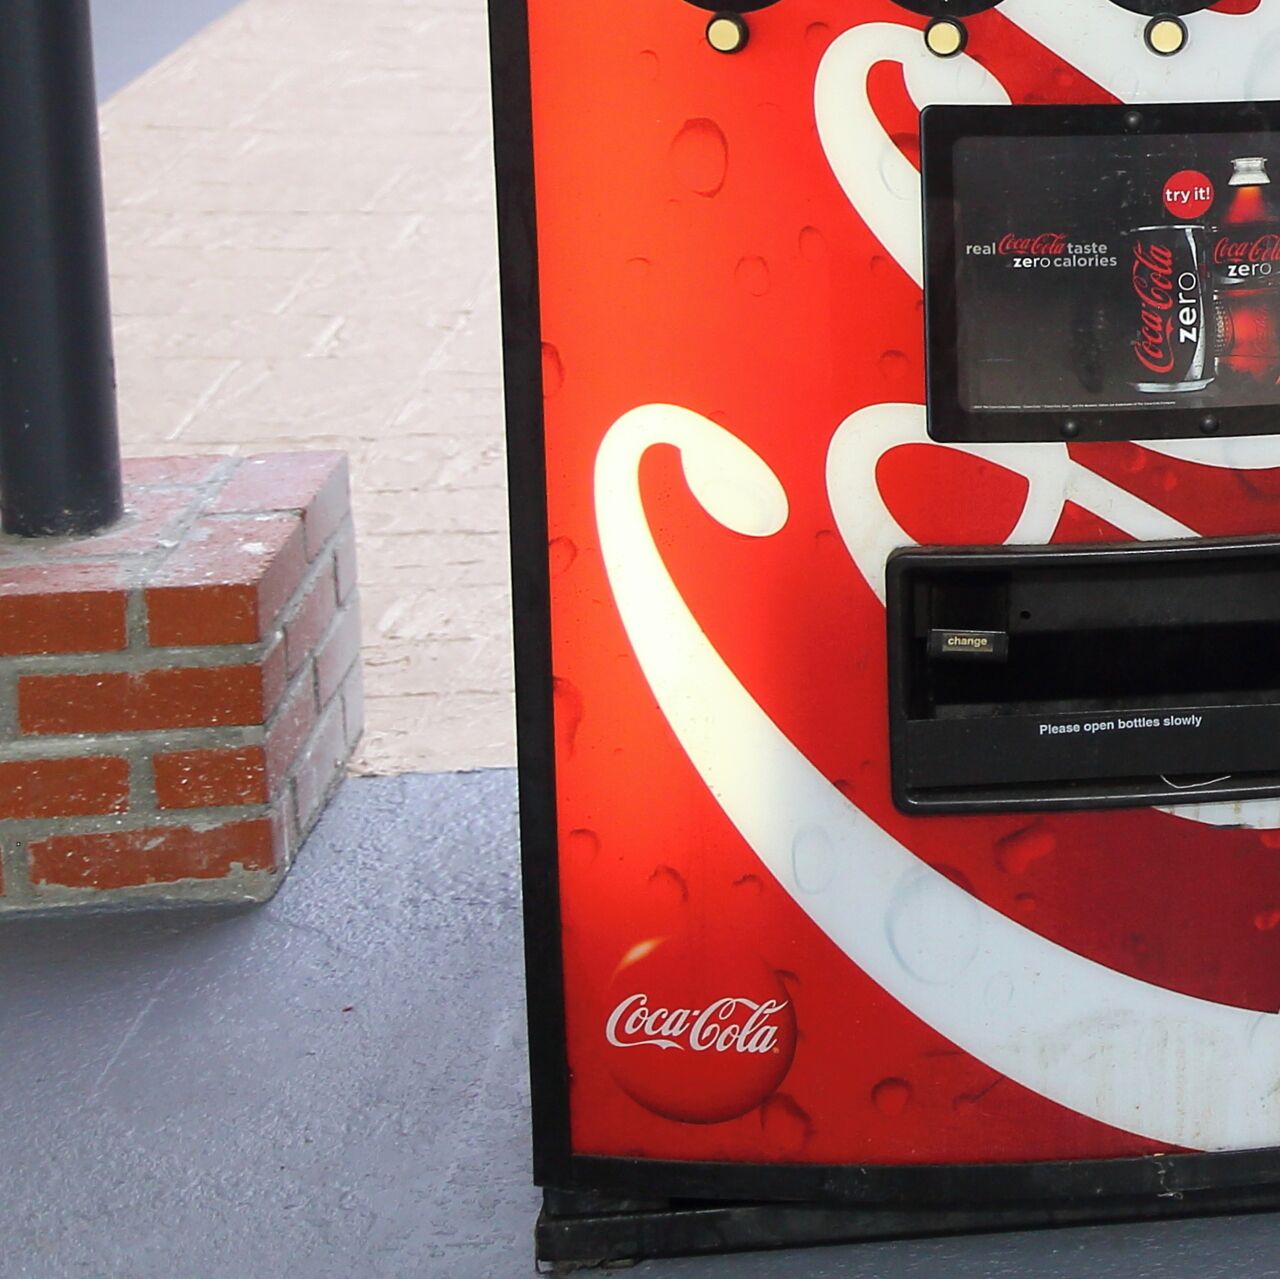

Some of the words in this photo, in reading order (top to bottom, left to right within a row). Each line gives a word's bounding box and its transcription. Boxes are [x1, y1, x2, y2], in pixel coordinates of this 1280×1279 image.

[1165, 188, 1190, 203] try
[1194, 187, 1211, 201] it!
[966, 243, 996, 256] real
[998, 232, 1070, 256] Coca-Cola
[1067, 241, 1108, 254] taste
[1013, 255, 1051, 269] zero
[1053, 254, 1118, 268] calories
[1227, 262, 1272, 277] zero
[1130, 241, 1175, 374] Coca-Cola
[1178, 271, 1199, 344] zero
[947, 635, 988, 648] change
[1039, 723, 1081, 736] Please
[1083, 719, 1114, 734] open
[1118, 716, 1160, 730] bottles
[1162, 714, 1202, 729] slowly
[605, 993, 789, 1054] Coca-Cola
